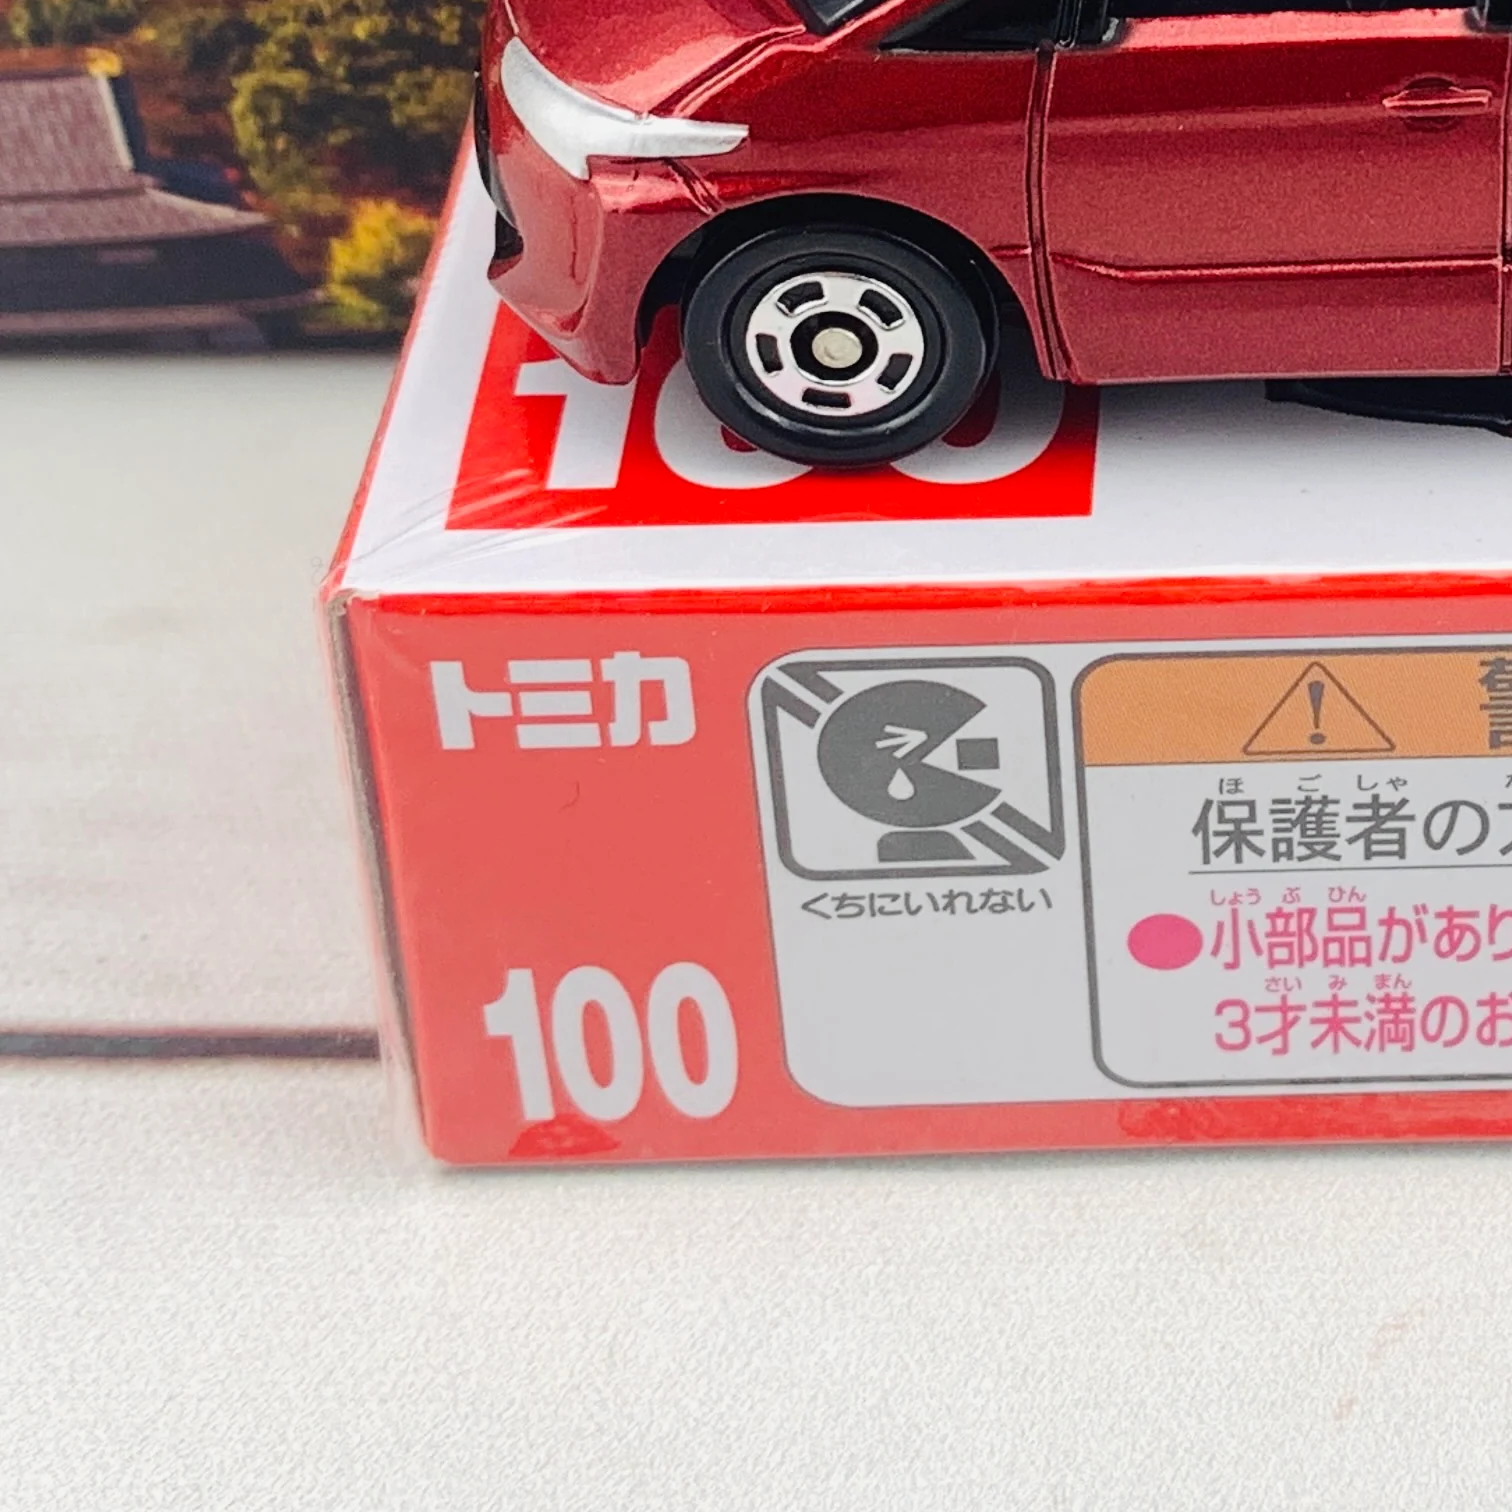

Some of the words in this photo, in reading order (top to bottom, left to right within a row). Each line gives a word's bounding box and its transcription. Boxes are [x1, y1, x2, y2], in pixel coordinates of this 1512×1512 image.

[430, 651, 697, 750] トミカ
[801, 887, 1053, 919] くちにいれない
[484, 961, 738, 1122] 100
